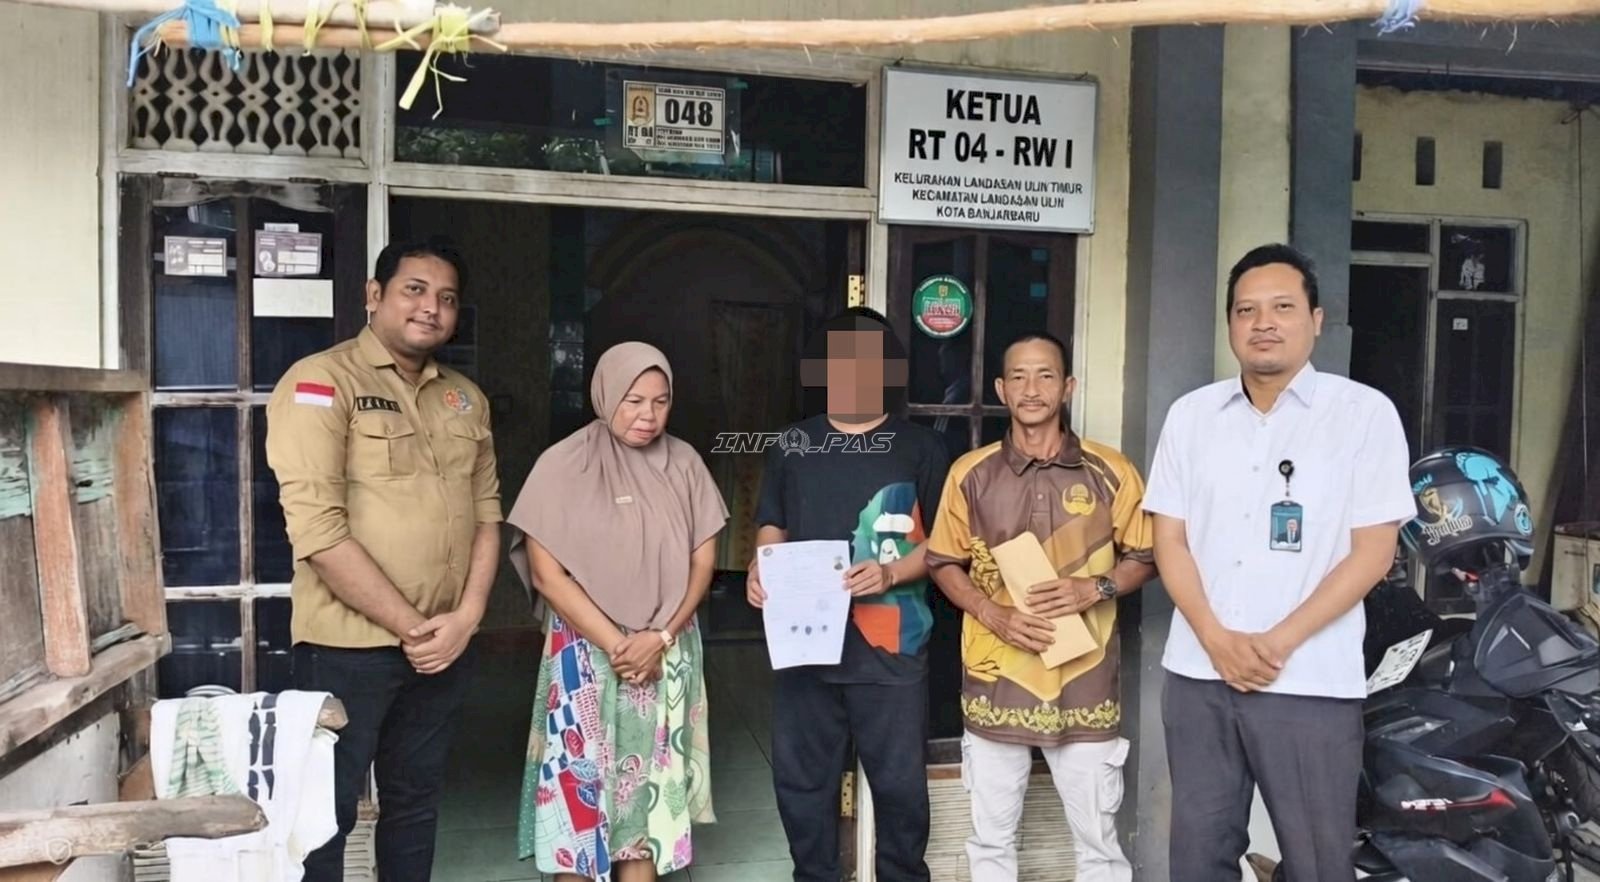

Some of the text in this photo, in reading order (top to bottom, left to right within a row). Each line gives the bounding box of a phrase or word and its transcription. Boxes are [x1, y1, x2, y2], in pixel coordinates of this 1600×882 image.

[665, 99, 713, 127] 048
[946, 89, 1041, 125] KETUA
[908, 128, 946, 160] RT
[955, 132, 987, 163] 04
[1013, 136, 1058, 167] RW
[1065, 139, 1073, 169] I
[894, 172, 1083, 194] KELURAHAN LANDASAN ULIN TIMUR
[912, 189, 1064, 208] KECAMATAN LANDASAN ULIN
[936, 206, 1040, 223] KOTA BANJARBARU
